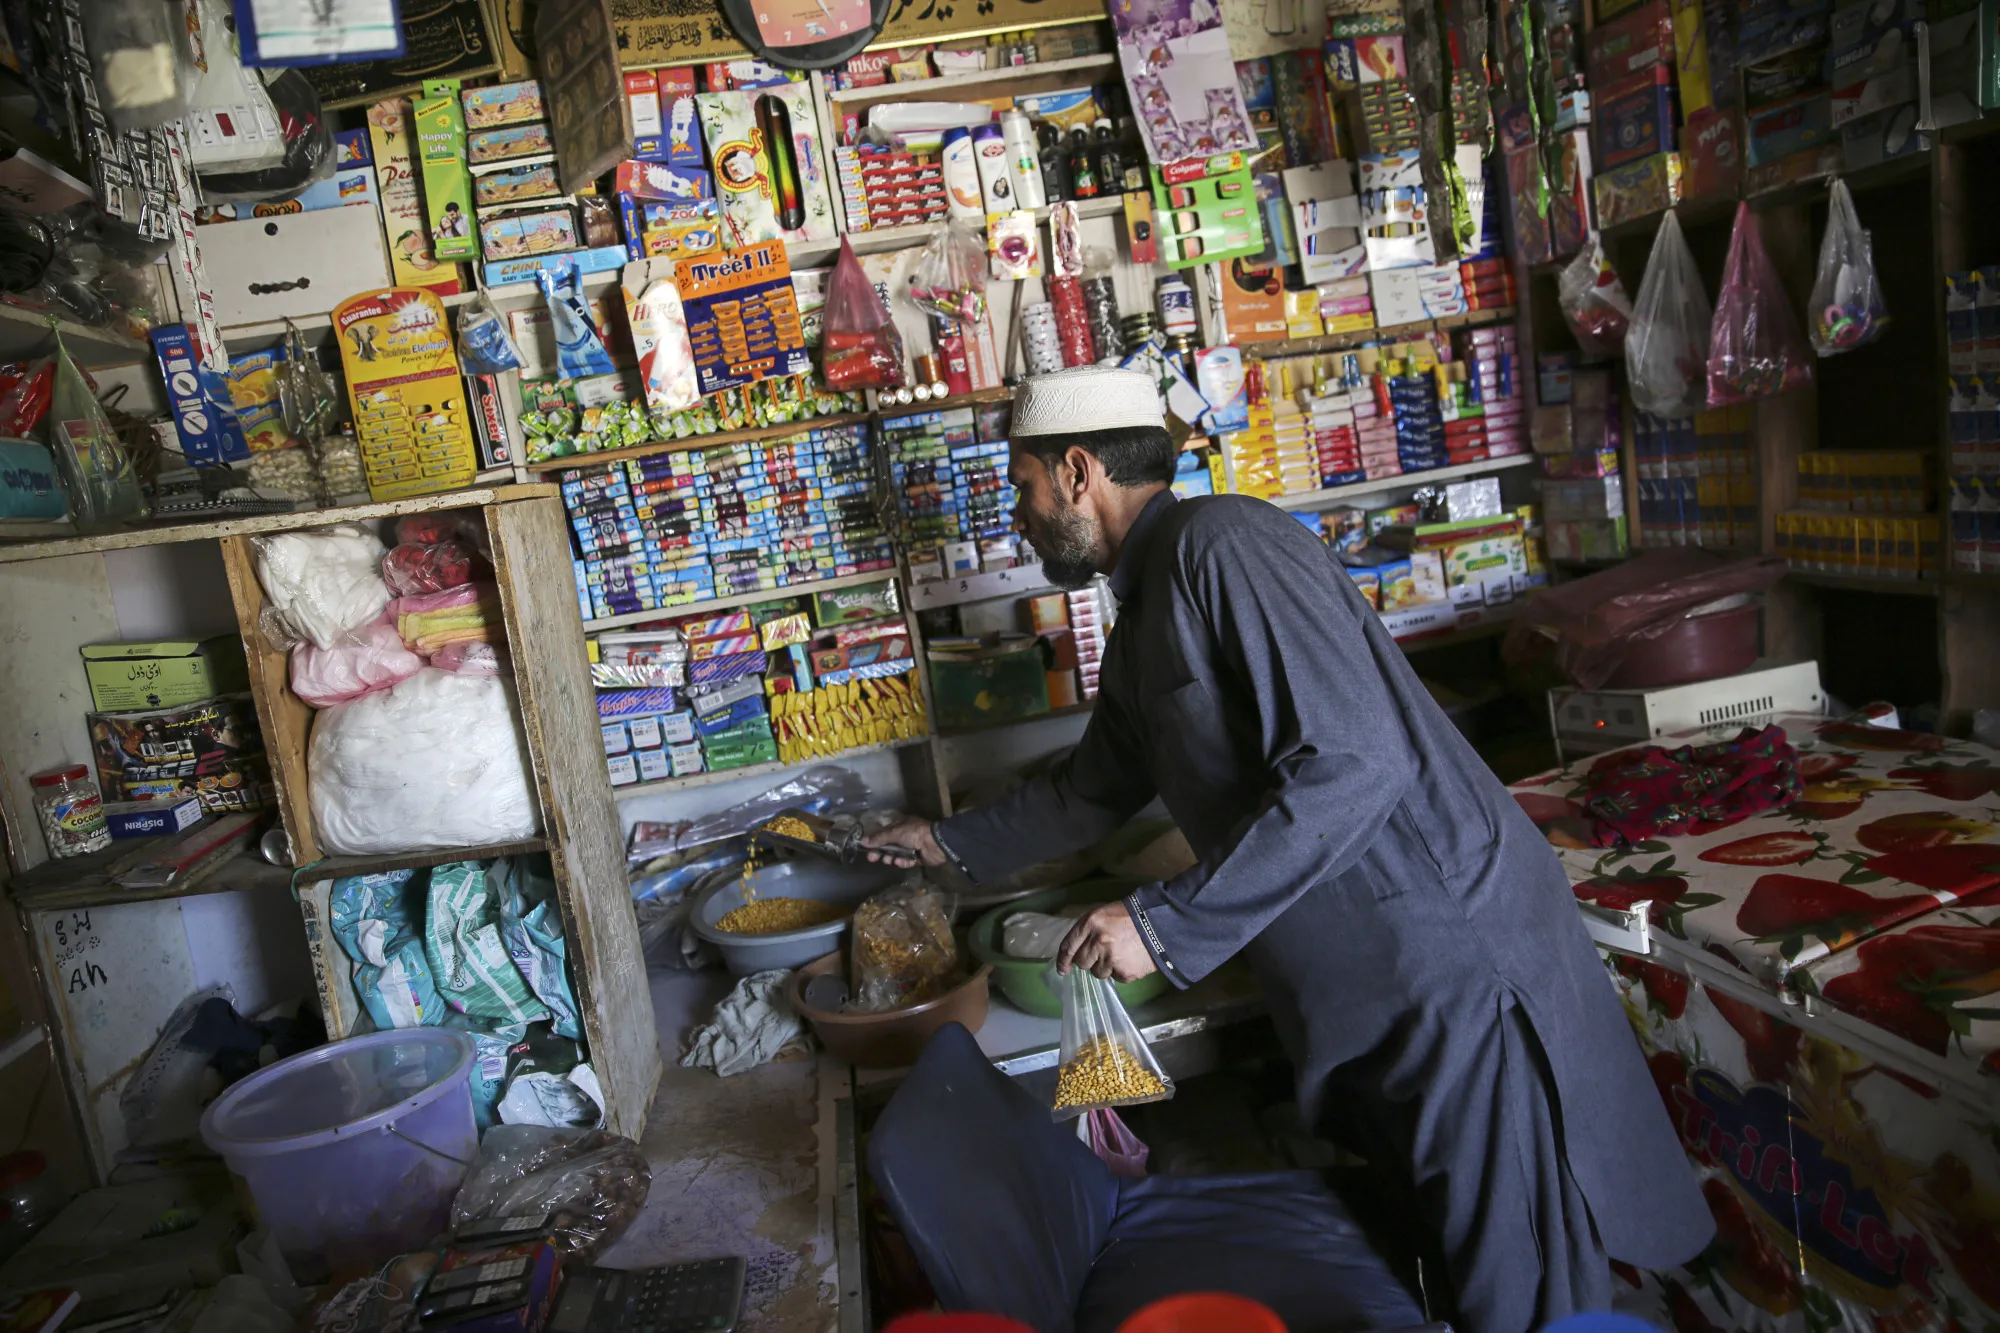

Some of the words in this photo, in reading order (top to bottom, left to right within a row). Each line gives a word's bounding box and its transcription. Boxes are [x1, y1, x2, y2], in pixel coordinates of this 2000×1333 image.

[784, 30, 792, 42] 7
[420, 132, 453, 142] Happy
[429, 144, 448, 153] Life
[390, 155, 409, 164] More
[1169, 163, 1204, 175] Colgate
[669, 208, 698, 221] ZOO
[500, 259, 543, 275] CHINA
[691, 252, 753, 281] Treet
[341, 306, 382, 326] Guarantee
[157, 334, 185, 343] EVEREADY
[169, 348, 183, 357] 500
[412, 339, 450, 354] Elephant
[482, 395, 500, 442] Sixer
[124, 819, 164, 832] DISPRIN
